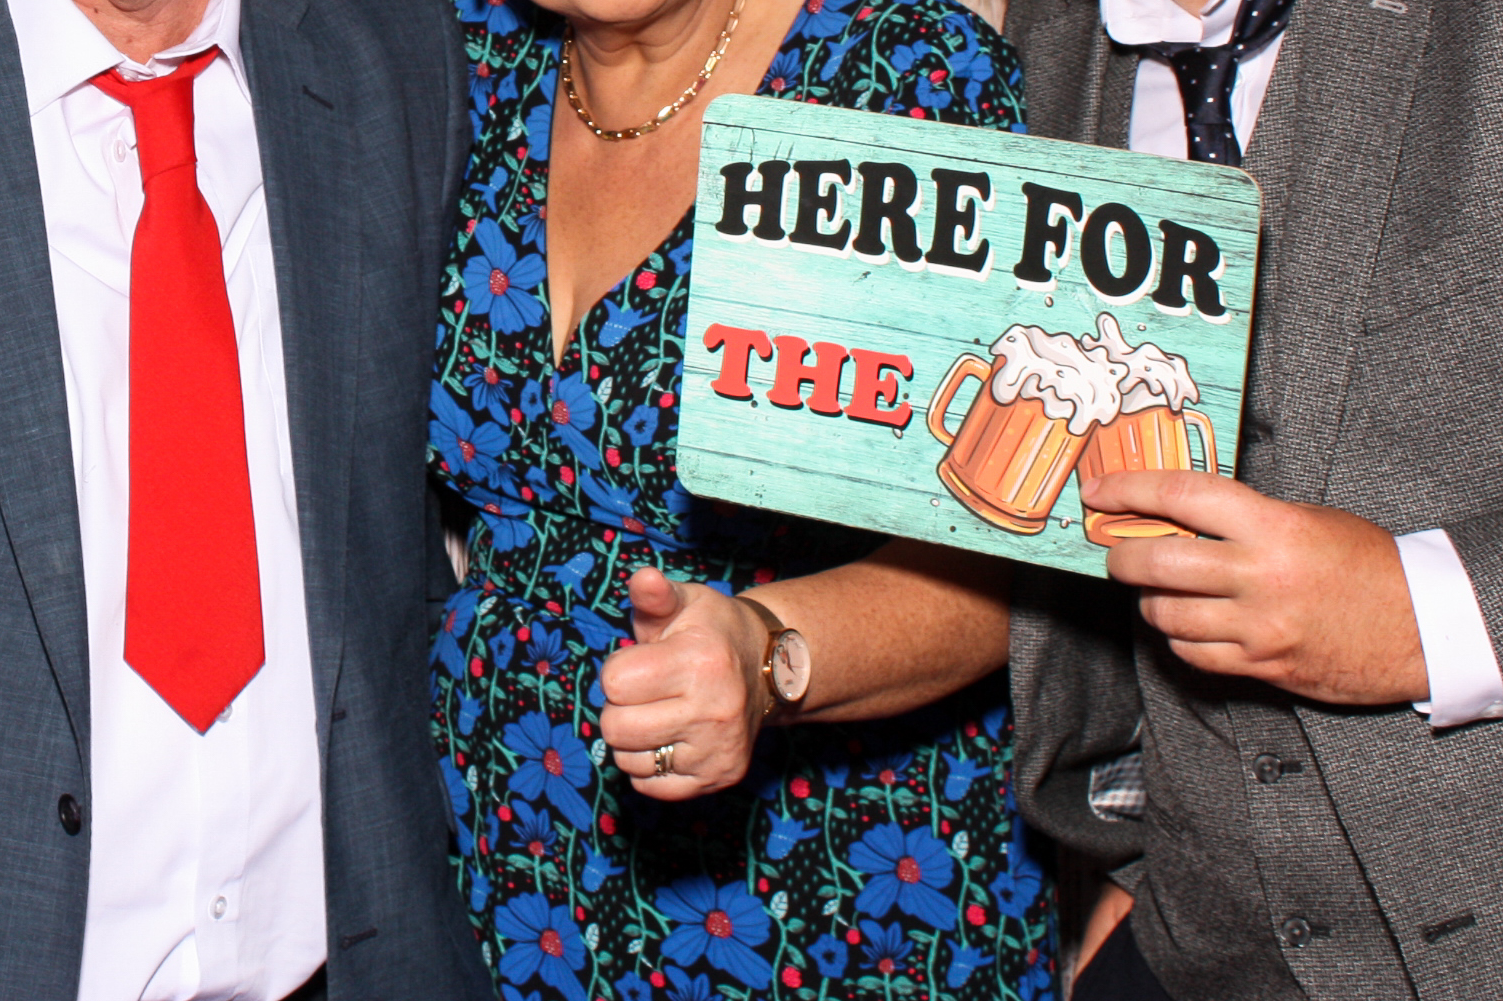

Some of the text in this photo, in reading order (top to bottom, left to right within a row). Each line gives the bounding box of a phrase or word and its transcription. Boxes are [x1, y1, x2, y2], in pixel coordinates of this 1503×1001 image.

[714, 157, 1232, 325] HERE FOR
[702, 322, 914, 430] THE
